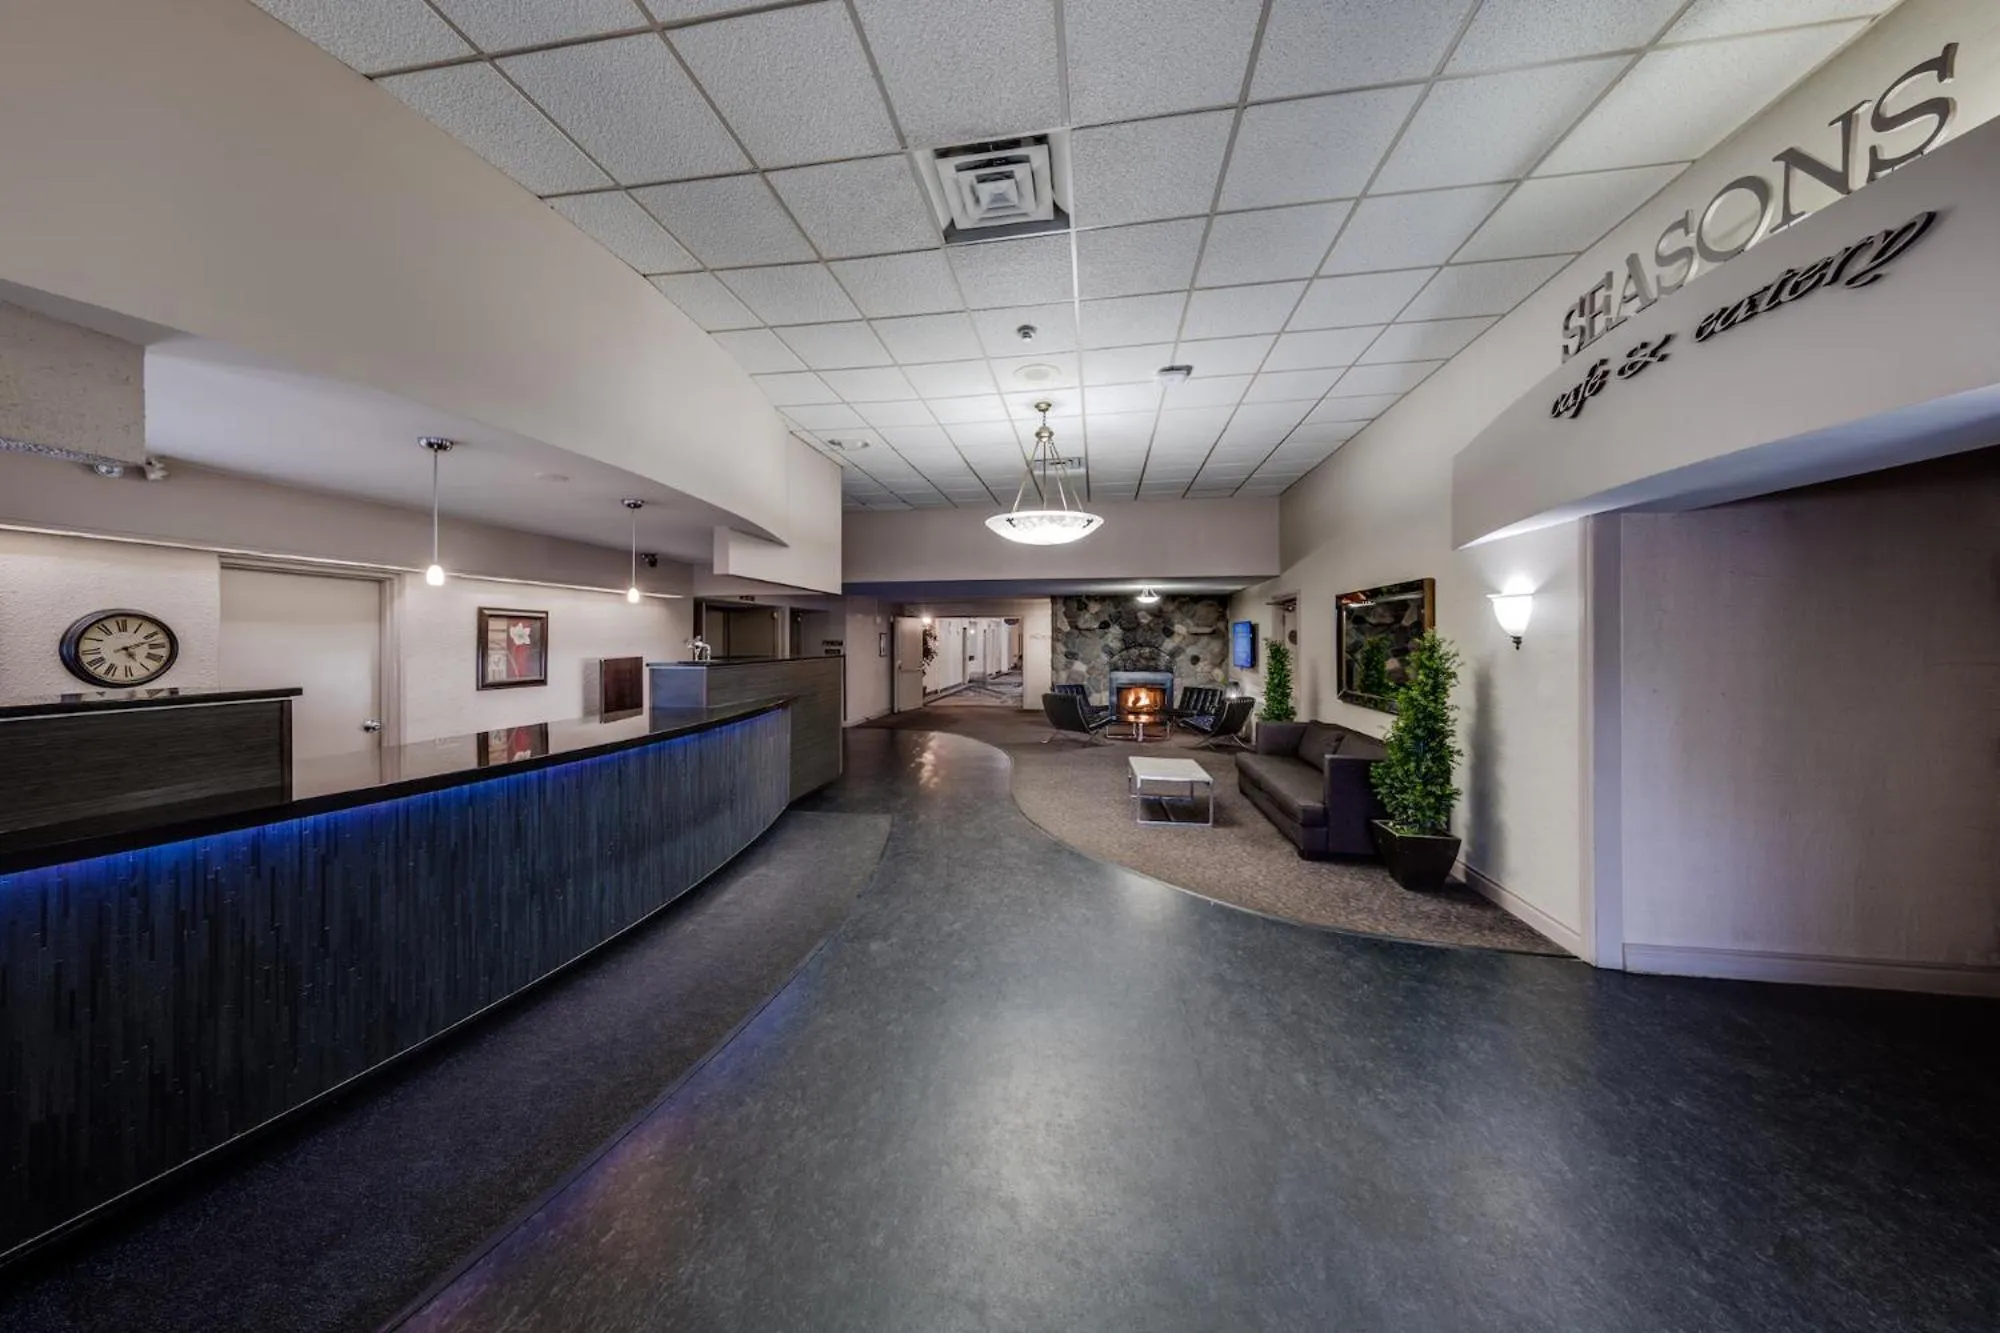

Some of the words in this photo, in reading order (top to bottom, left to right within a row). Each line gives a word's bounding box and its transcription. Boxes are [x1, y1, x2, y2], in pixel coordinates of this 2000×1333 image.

[1562, 42, 1958, 364] SEASONS
[1617, 333, 1676, 380] &
[1695, 210, 1938, 342] eatery
